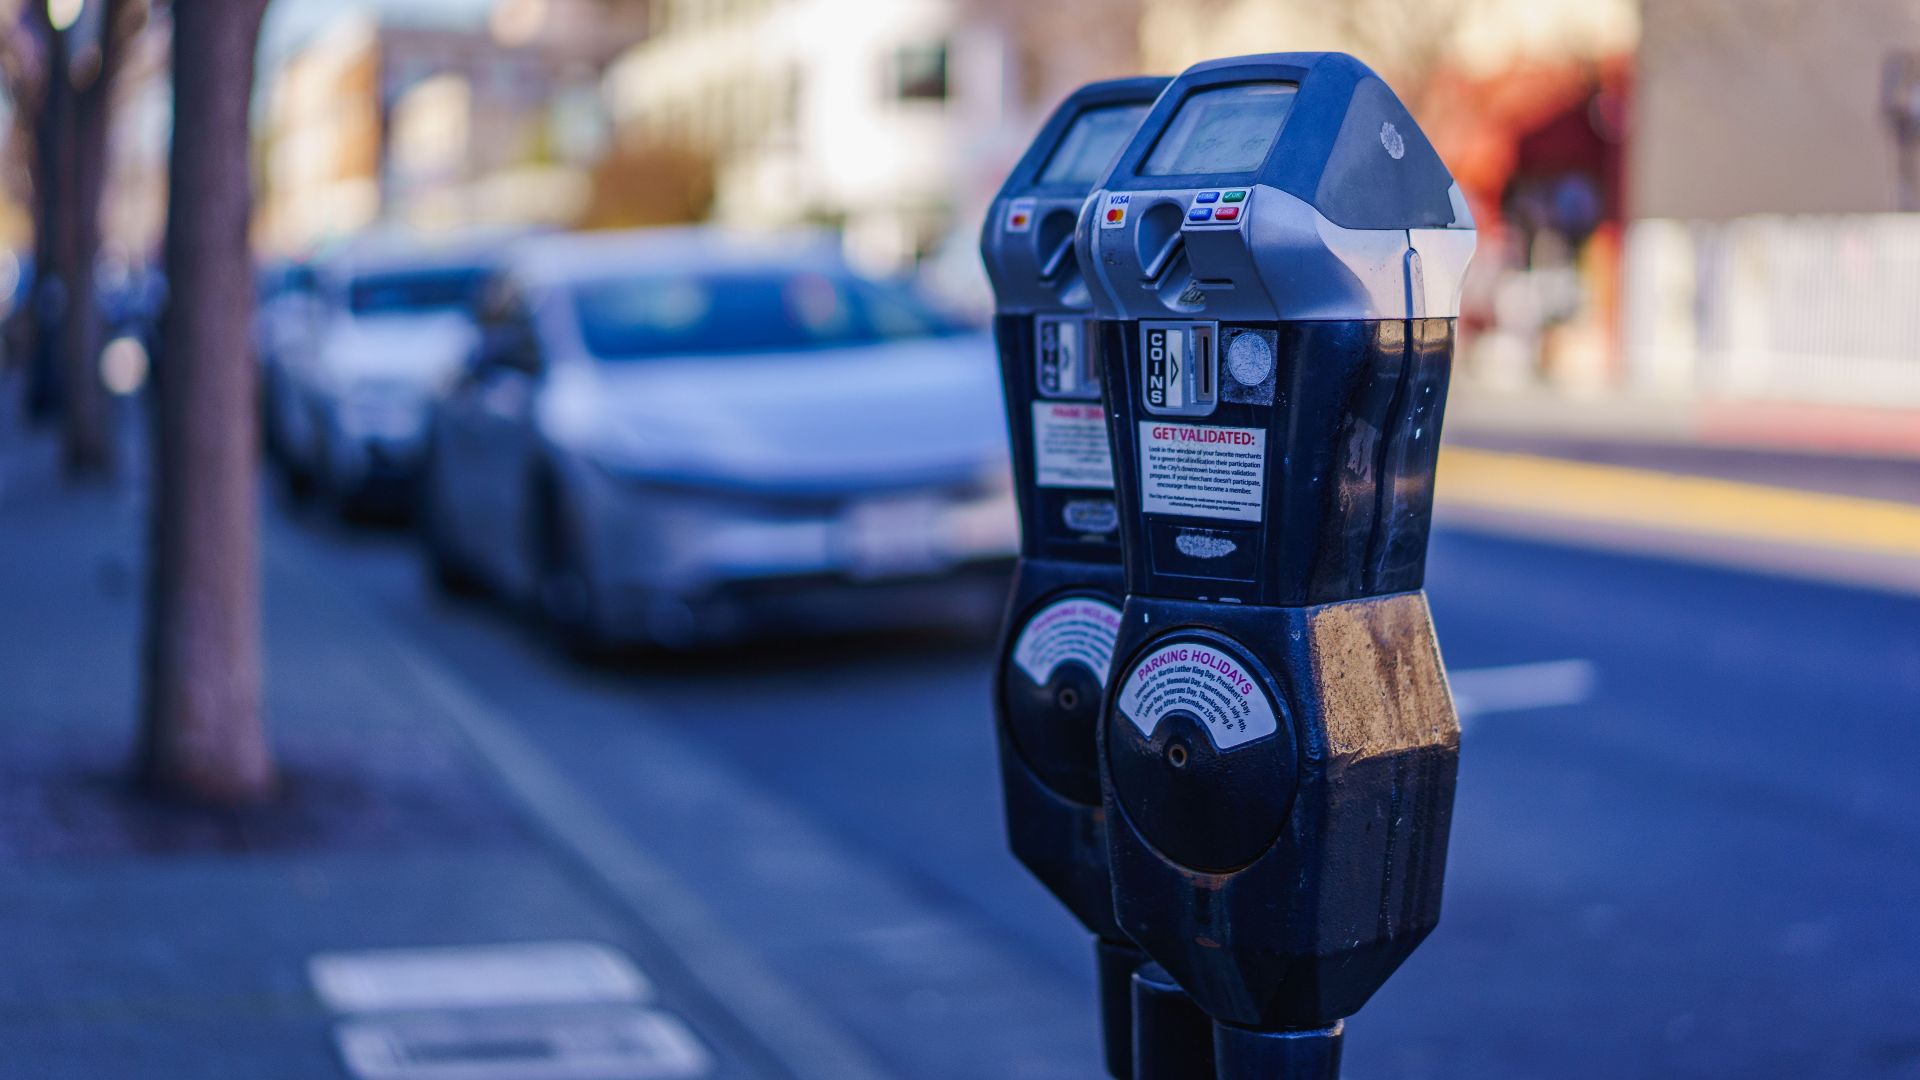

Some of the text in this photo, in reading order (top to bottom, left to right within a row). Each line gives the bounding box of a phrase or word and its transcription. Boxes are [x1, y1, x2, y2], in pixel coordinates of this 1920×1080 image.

[1110, 195, 1129, 204] VISA
[1150, 333, 1163, 404] COINS
[1152, 427, 1255, 446] GET VALIDATED:
[1181, 465, 1208, 473] downtown
[1231, 469, 1256, 477] validation
[1228, 460, 1261, 468] participation
[1156, 482, 1182, 490] encourage
[1188, 475, 1212, 483] merchant
[1138, 649, 1188, 681] PARKING
[1191, 649, 1252, 695] HOLIDAYS
[1135, 680, 1150, 700] January
[1158, 667, 1174, 677] Martin
[1174, 665, 1192, 673] Luther
[1191, 666, 1204, 677] King
[1204, 669, 1216, 682] Day,
[1216, 676, 1245, 703] President's
[1240, 701, 1251, 716] Day,
[1143, 701, 1154, 717] Labor
[1163, 687, 1186, 696] Veterans
[1186, 687, 1198, 698] Day,
[1198, 691, 1229, 725] Thanksgiving
[1154, 705, 1163, 716] Day
[1177, 696, 1205, 711] December
[1203, 708, 1216, 724] 25th
[1166, 677, 1191, 685] Memorial
[1190, 677, 1202, 688] Day,
[1202, 682, 1231, 708] Juneteenth,
[1230, 706, 1240, 719] July
[1238, 718, 1247, 733] 4th,
